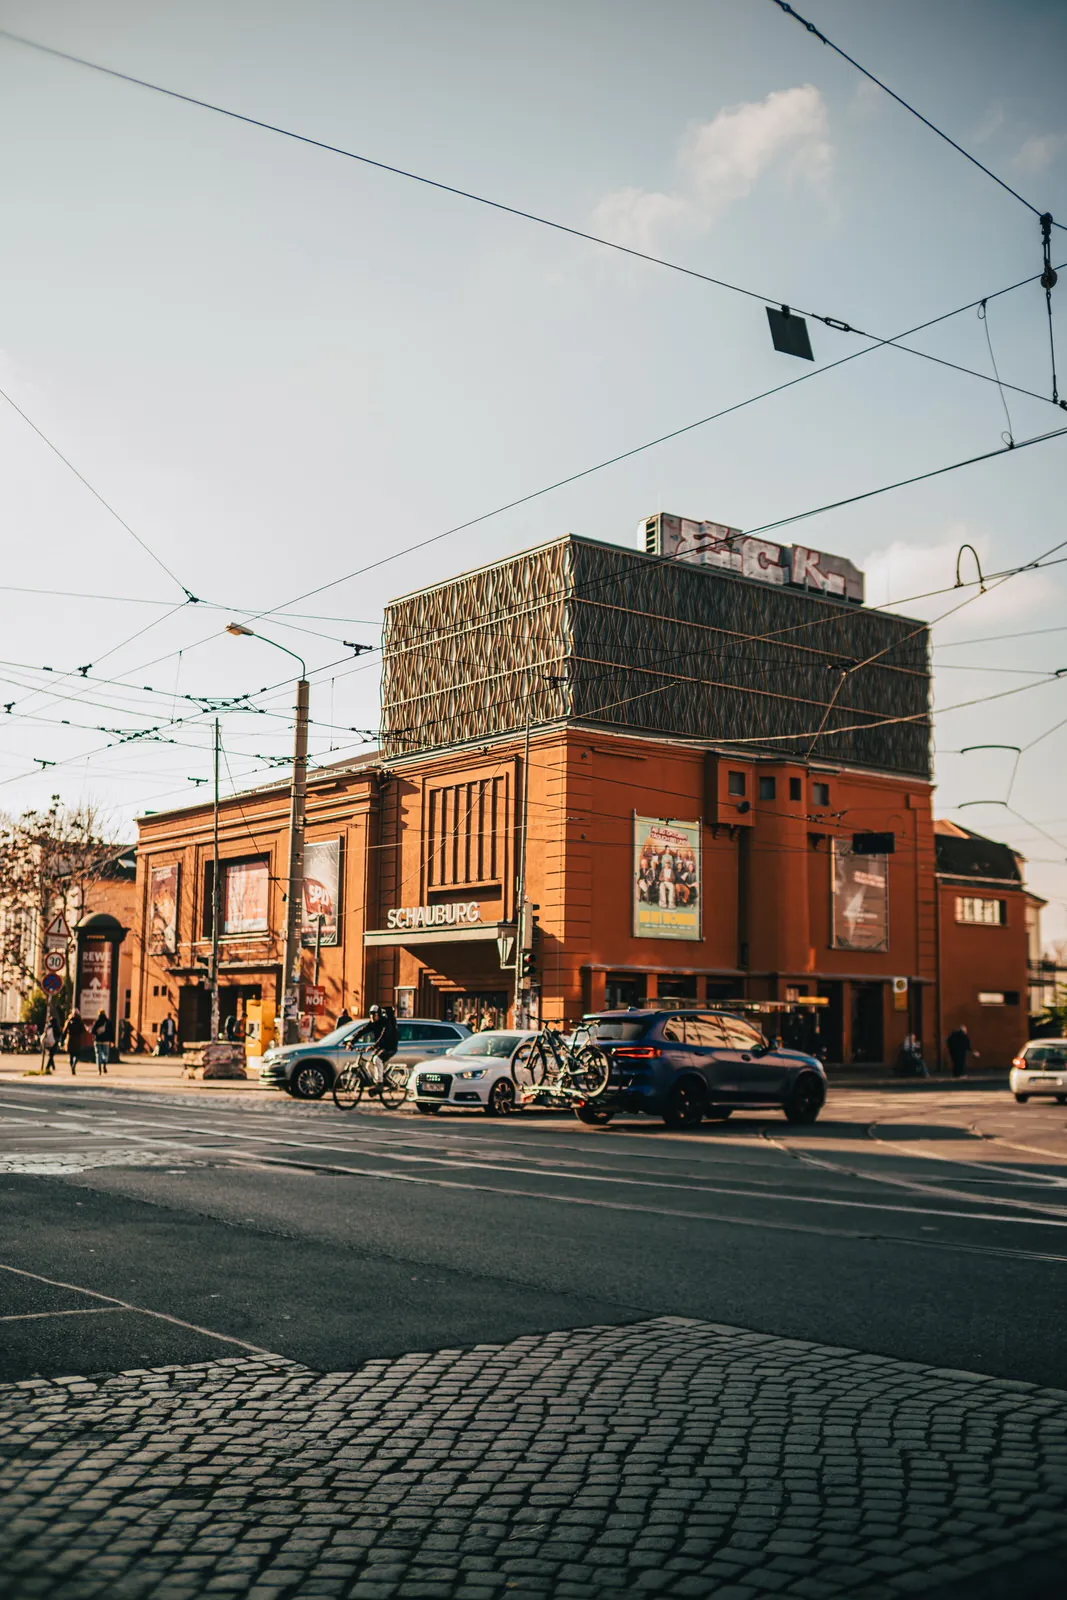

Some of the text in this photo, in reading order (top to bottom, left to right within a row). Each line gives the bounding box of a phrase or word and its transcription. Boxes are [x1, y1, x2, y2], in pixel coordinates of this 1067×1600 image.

[387, 901, 481, 929] SCHAUBURG
[49, 957, 61, 967] 30
[82, 951, 112, 962] REWE
